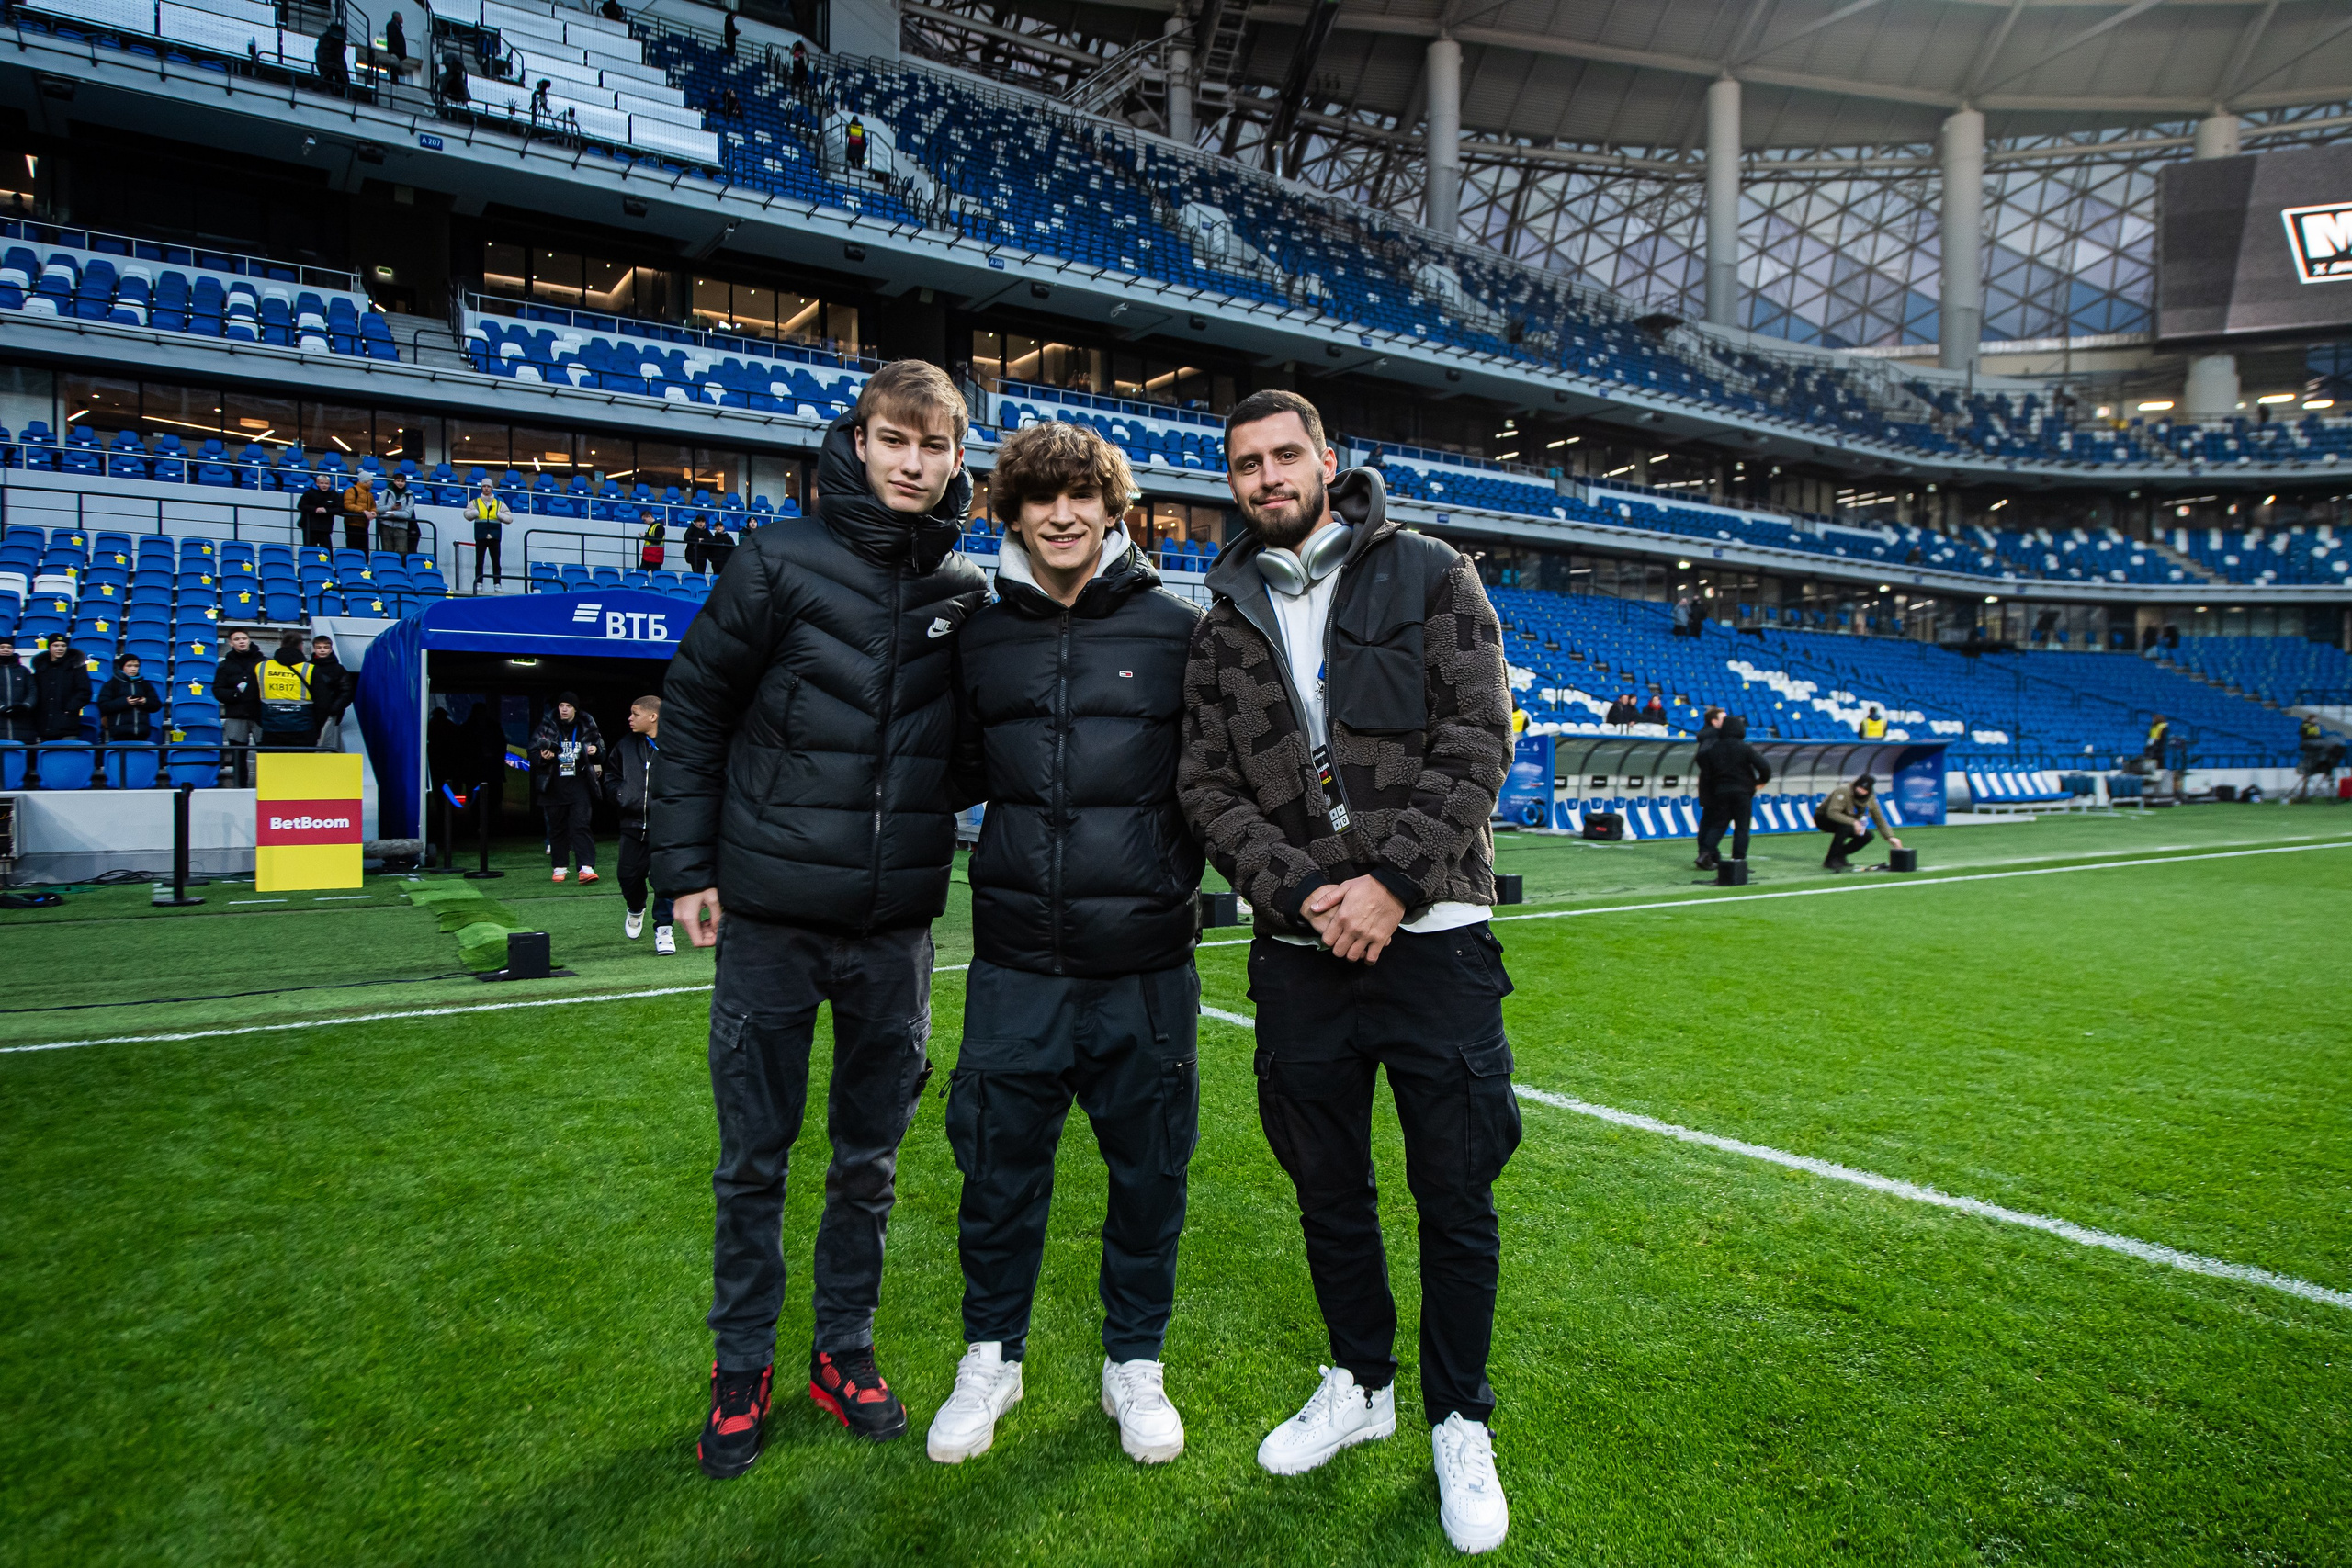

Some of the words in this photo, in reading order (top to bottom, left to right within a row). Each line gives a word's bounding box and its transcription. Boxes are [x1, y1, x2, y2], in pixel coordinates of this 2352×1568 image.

[428, 138, 441, 146] 207
[606, 611, 668, 640] ВТБ
[933, 617, 952, 633] NIKE
[268, 682, 295, 692] K1817
[270, 816, 350, 829] BetBoom
